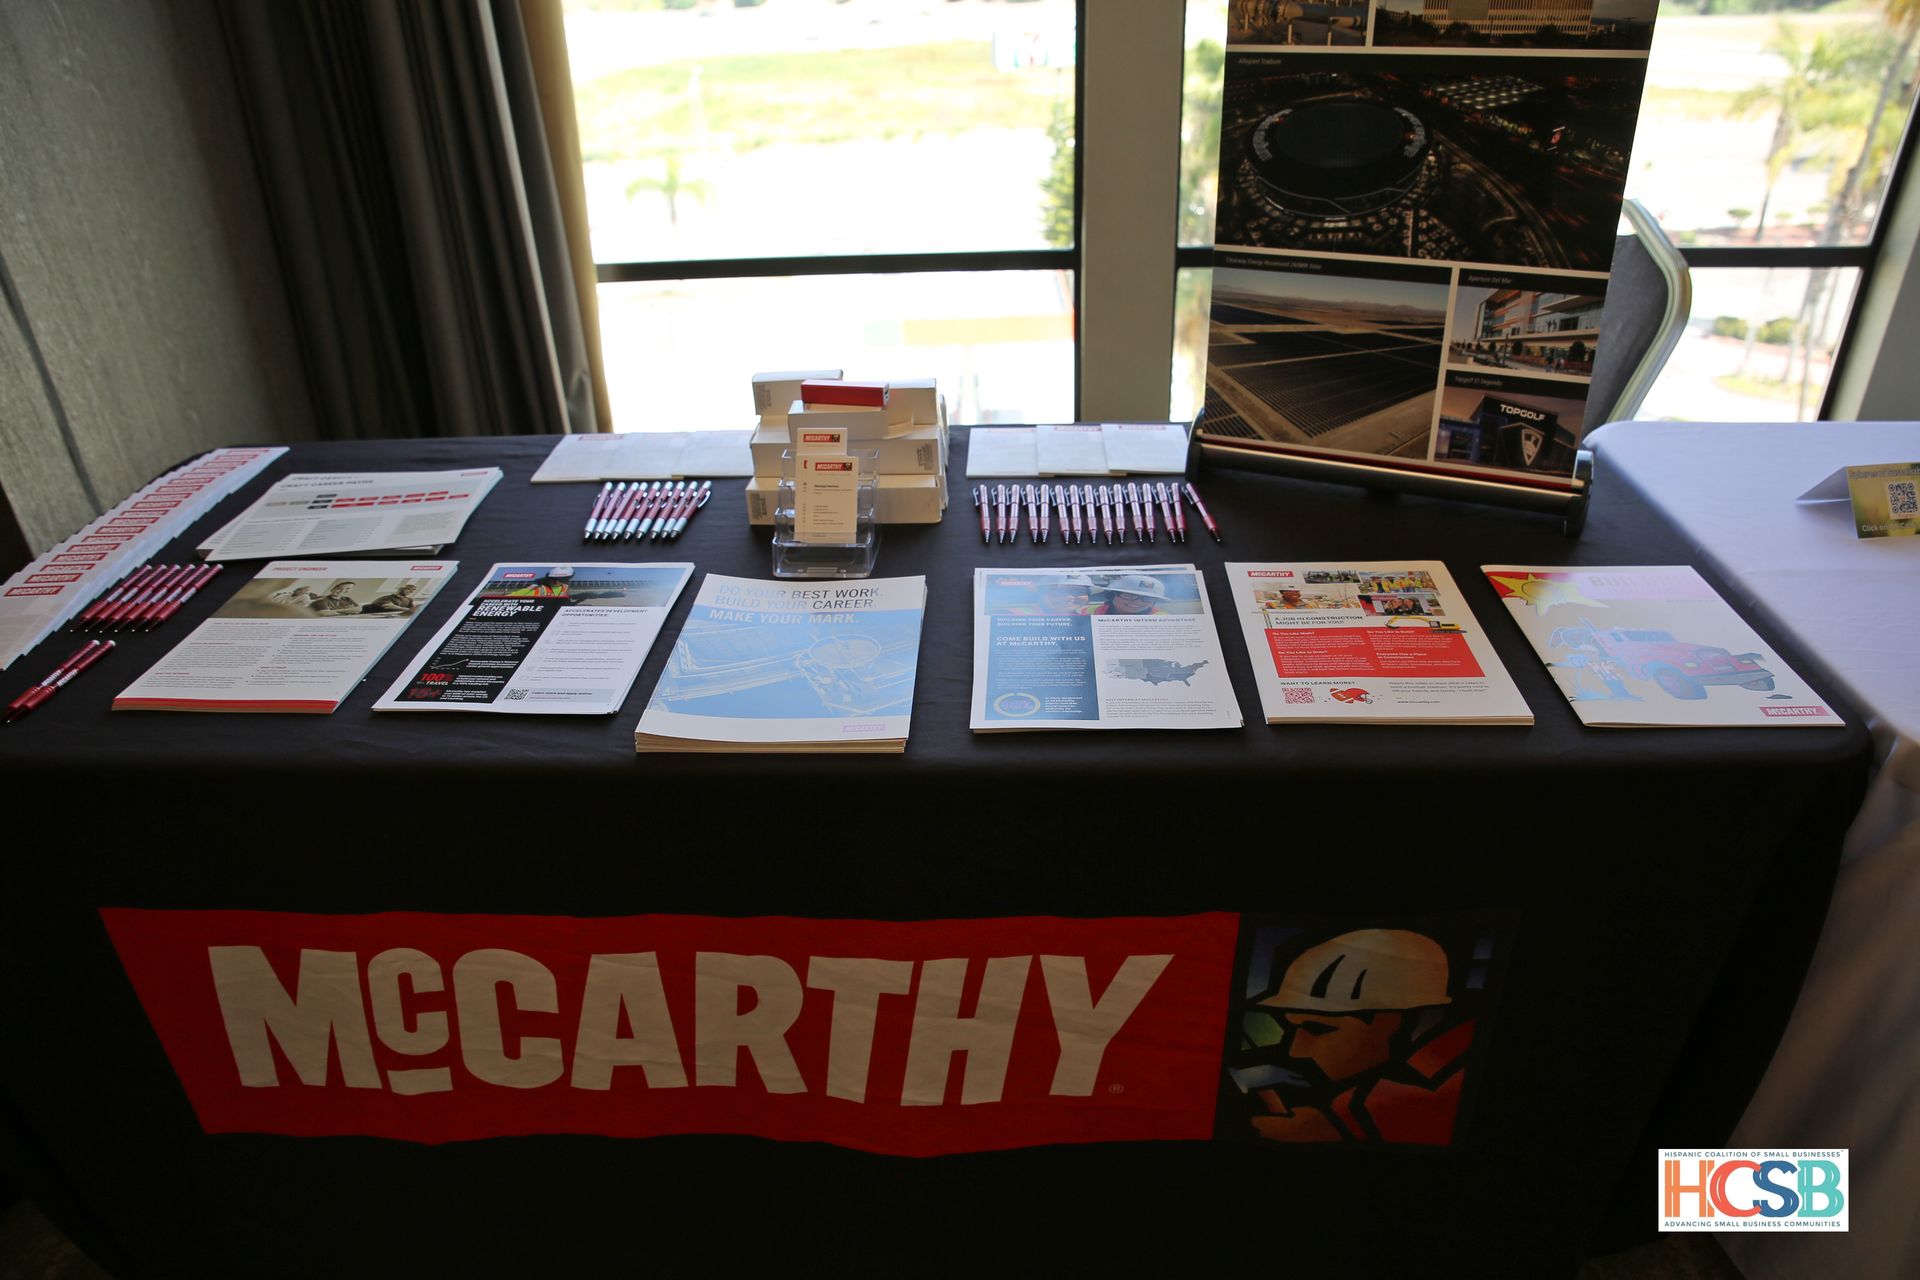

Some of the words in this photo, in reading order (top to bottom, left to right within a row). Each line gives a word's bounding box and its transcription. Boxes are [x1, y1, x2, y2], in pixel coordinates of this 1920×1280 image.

[1500, 404, 1546, 421] TOPGOLF
[747, 587, 786, 599] YOUR
[792, 589, 830, 599] BEST
[714, 595, 760, 608] BUILD
[767, 598, 807, 609] YOUR
[708, 608, 754, 622] MAKE
[759, 613, 802, 625] YOUR
